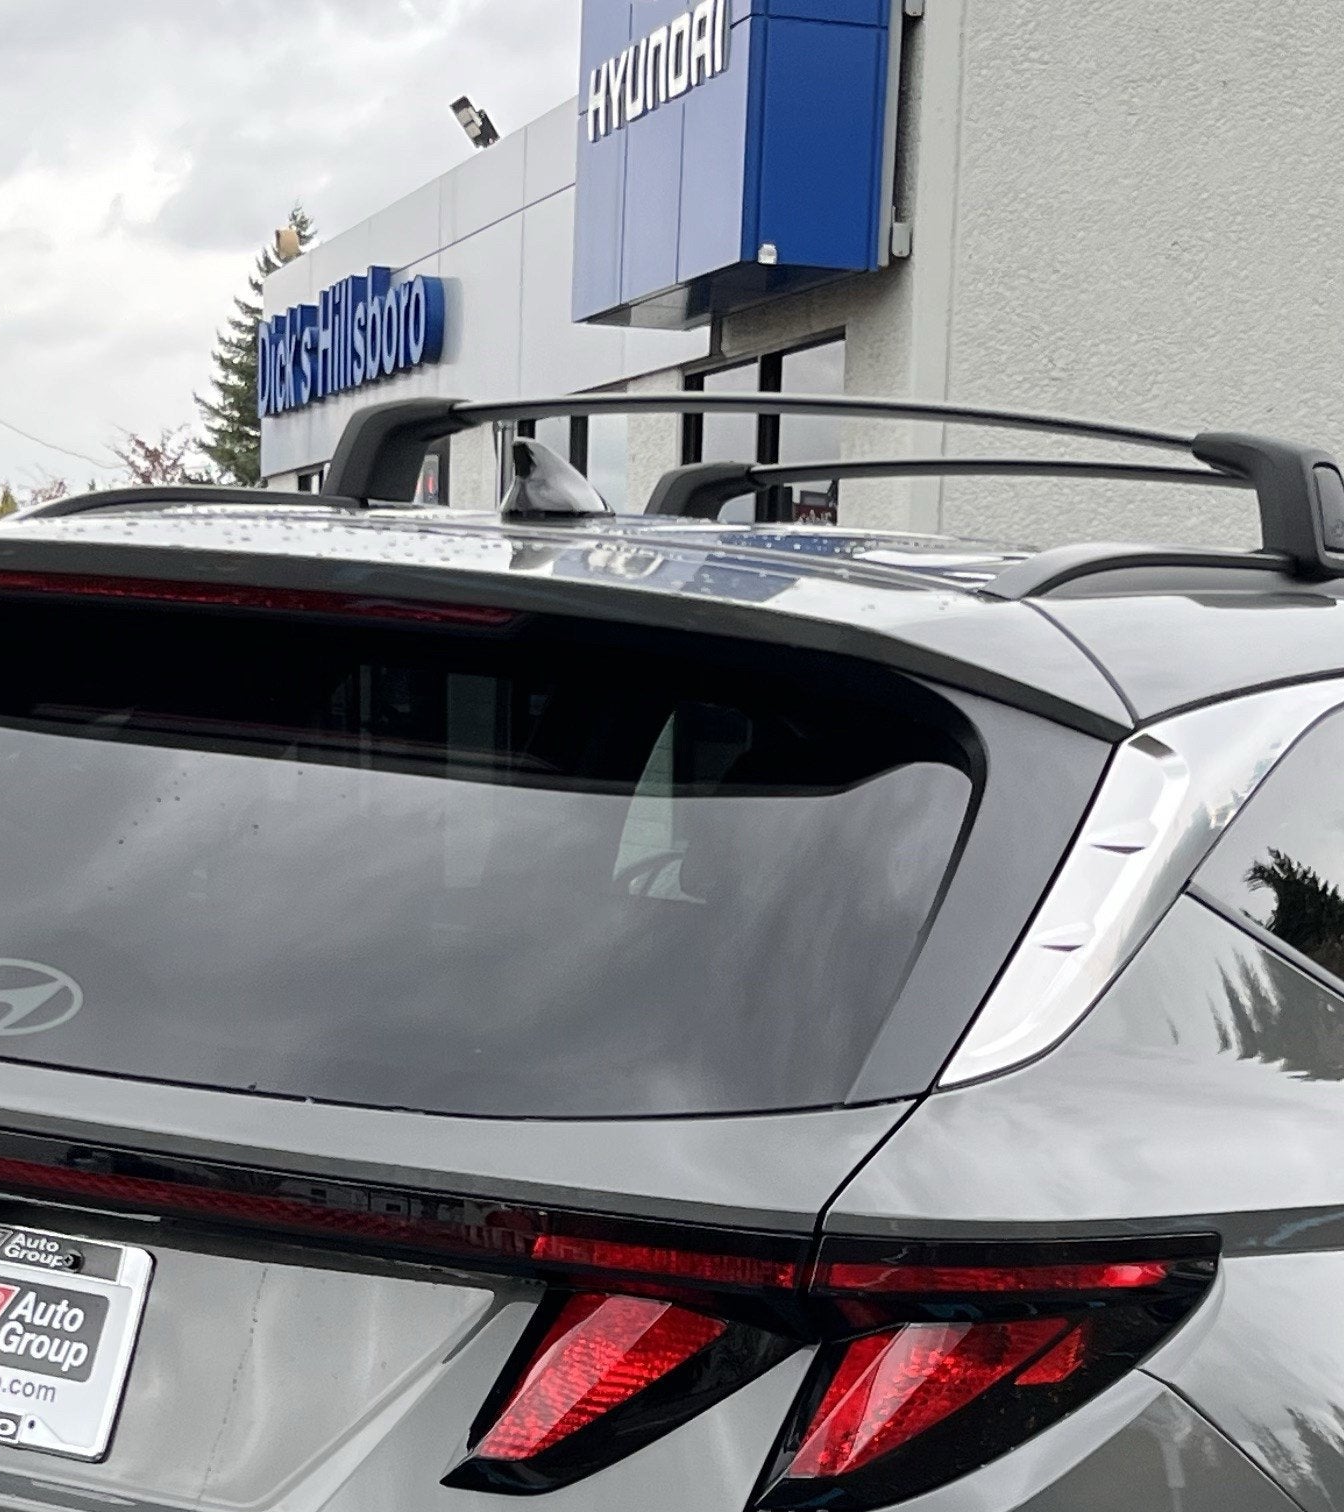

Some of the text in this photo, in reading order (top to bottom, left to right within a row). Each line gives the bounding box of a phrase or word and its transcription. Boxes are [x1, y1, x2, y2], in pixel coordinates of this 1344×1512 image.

[587, 0, 727, 141] HYUNDAI
[258, 266, 426, 418] Dick's Hillsboro
[9, 1233, 60, 1253] Auto
[9, 1291, 85, 1332] Auto
